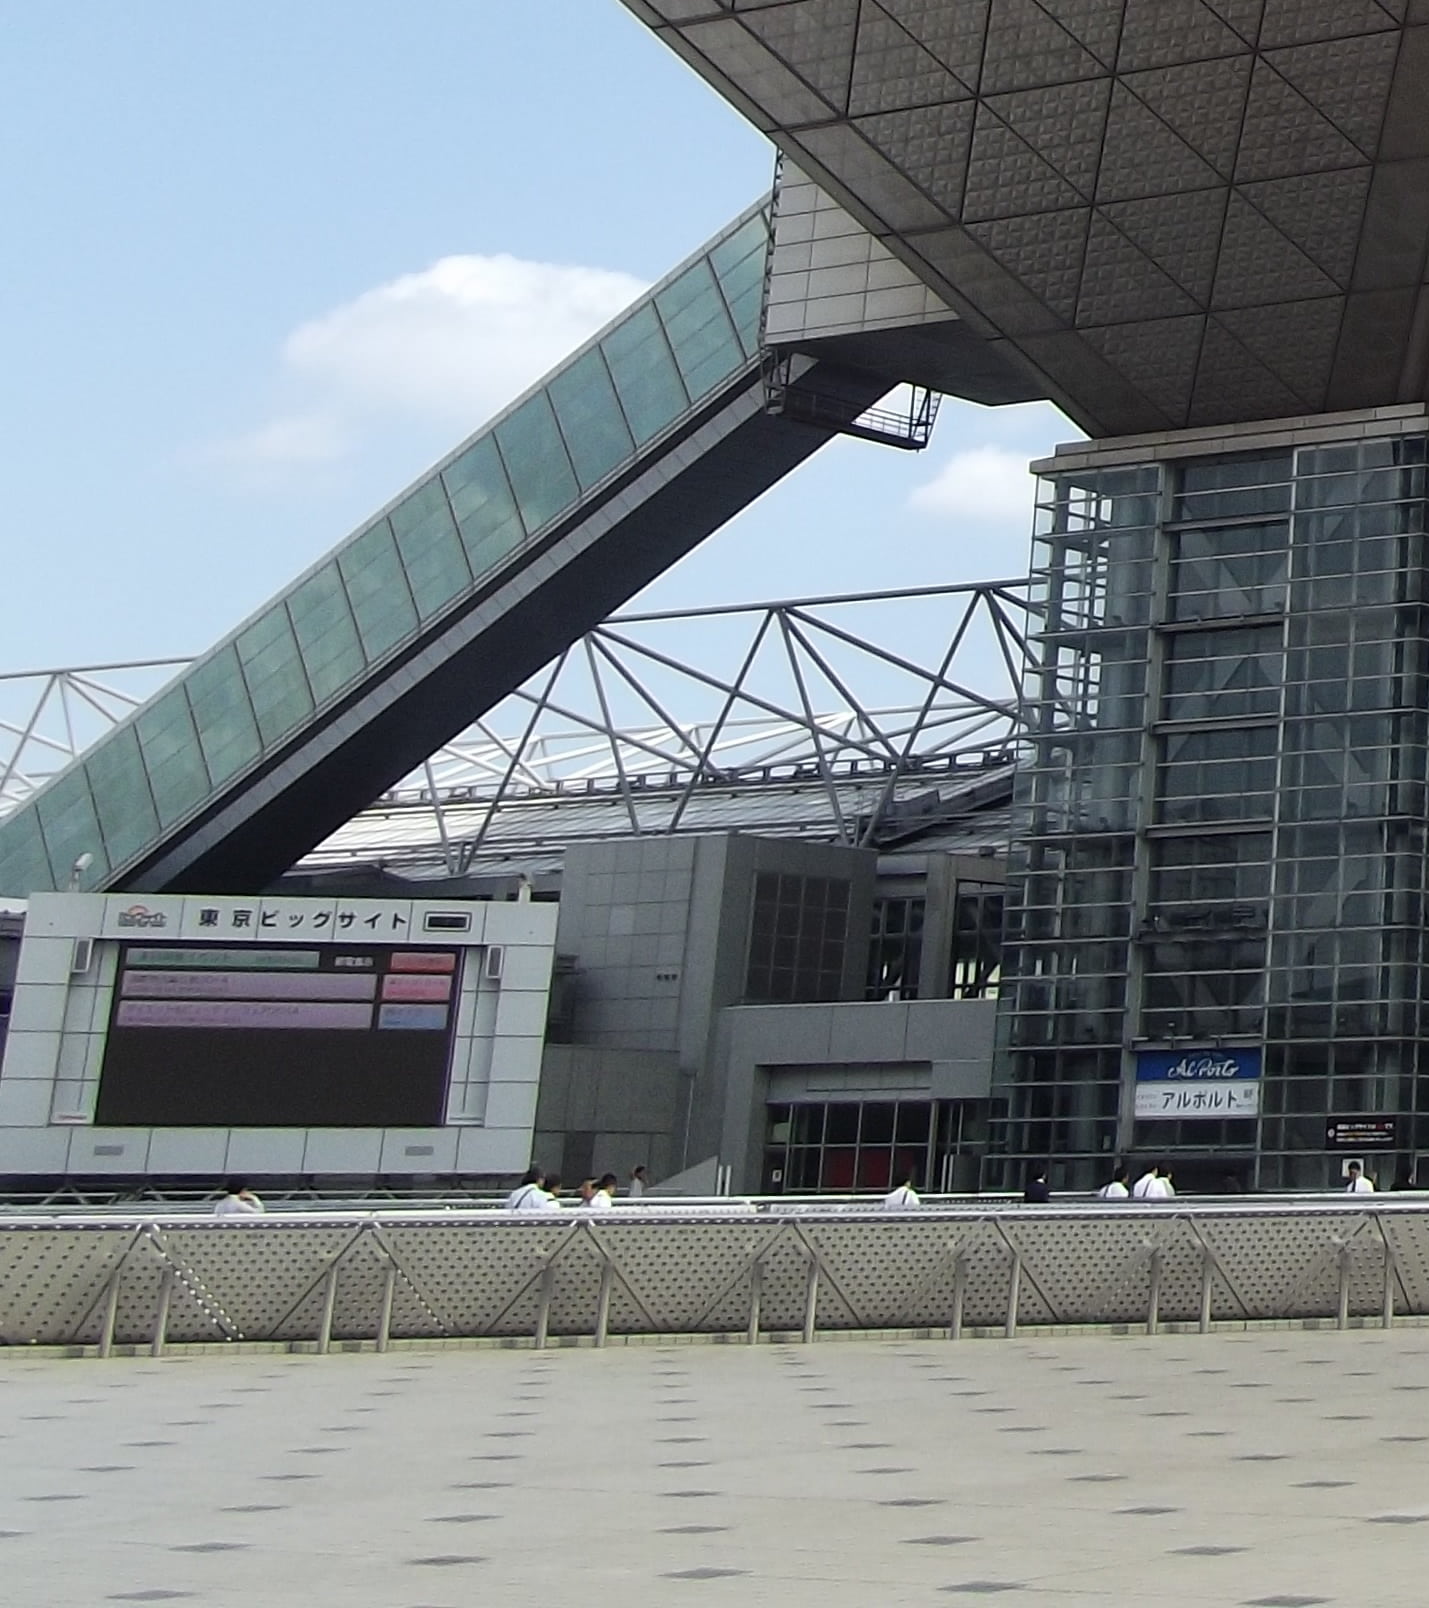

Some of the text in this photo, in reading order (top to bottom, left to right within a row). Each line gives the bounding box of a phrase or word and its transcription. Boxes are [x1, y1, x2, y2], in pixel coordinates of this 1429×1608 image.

[198, 907, 407, 929] 東京ビッグサイト
